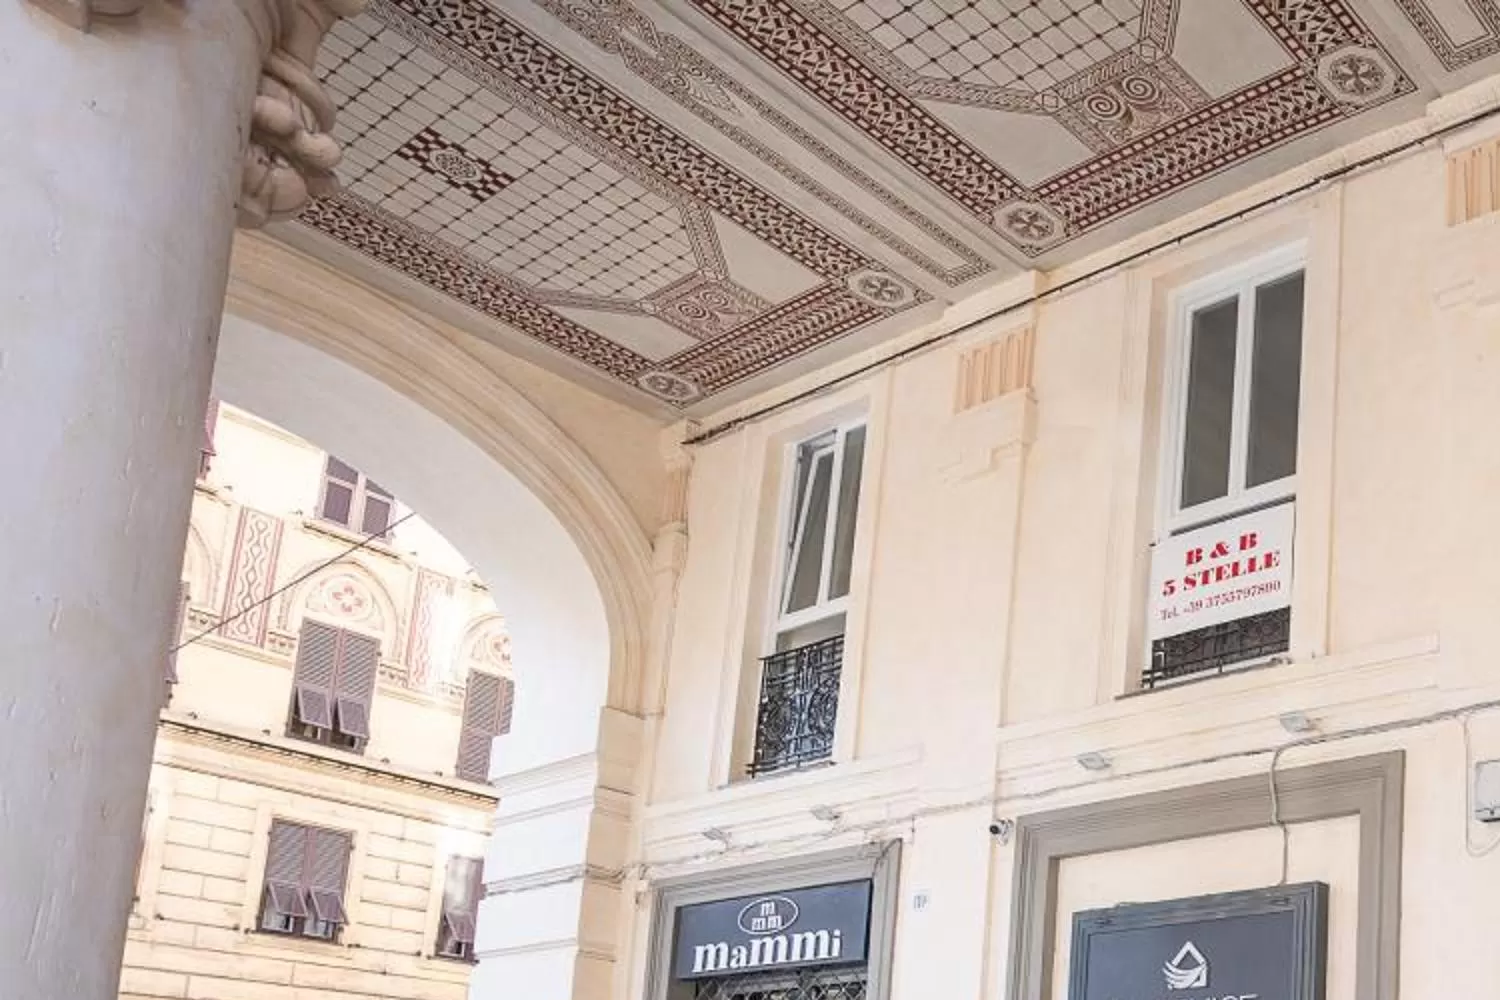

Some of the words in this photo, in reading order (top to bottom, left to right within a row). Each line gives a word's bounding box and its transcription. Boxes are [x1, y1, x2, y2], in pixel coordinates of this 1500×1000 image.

[1186, 547, 1203, 566] B
[1210, 542, 1229, 559] &
[1240, 532, 1257, 550] B
[1163, 579, 1175, 596] 5
[1183, 550, 1280, 591] STELLE
[691, 928, 842, 974] mammi
